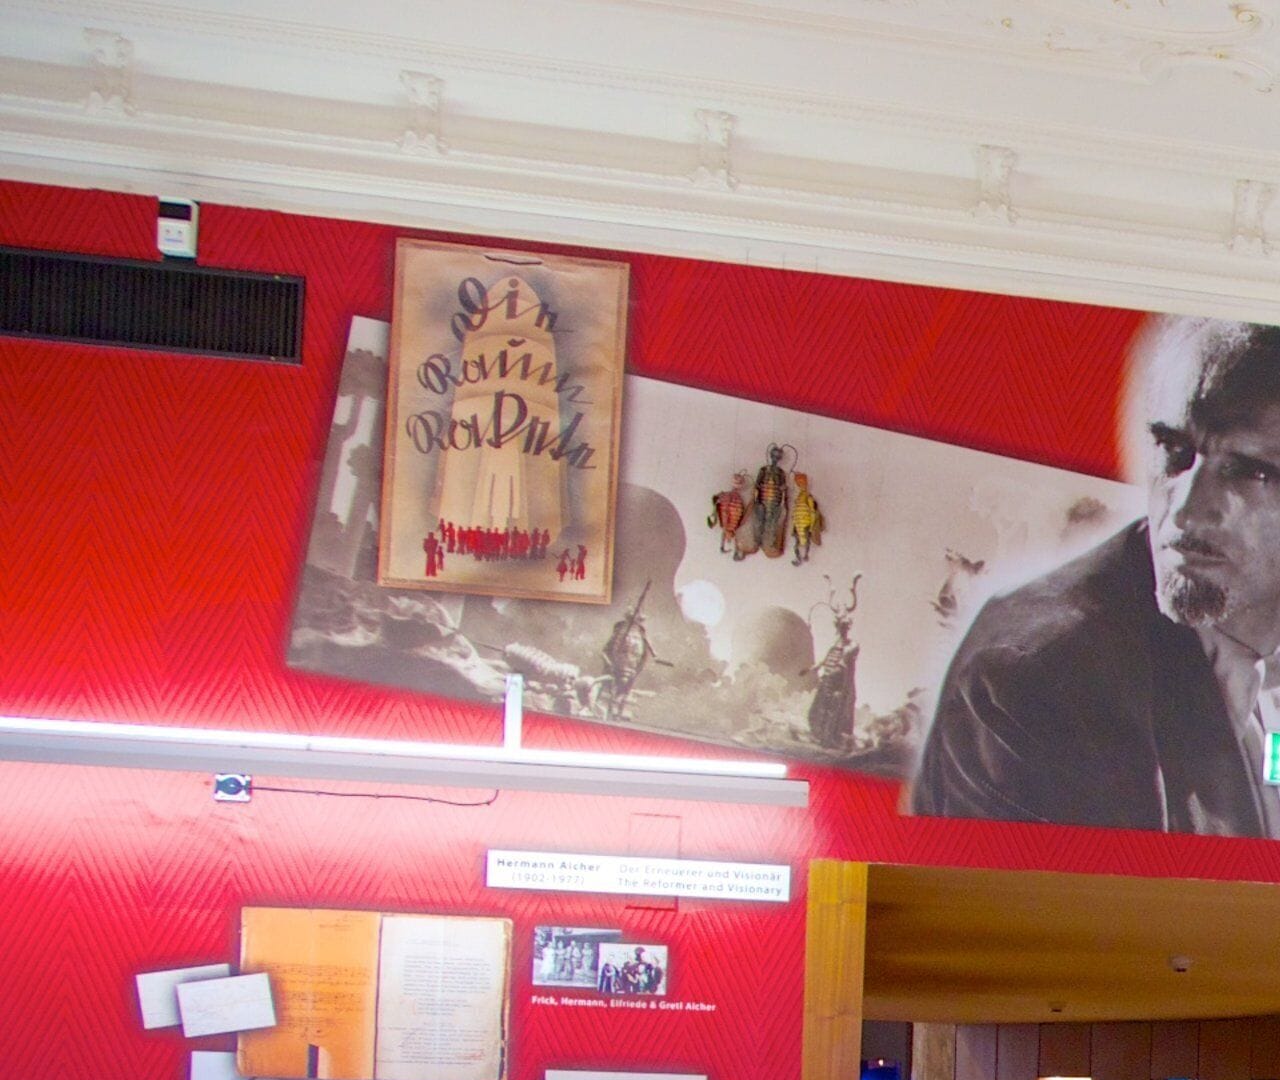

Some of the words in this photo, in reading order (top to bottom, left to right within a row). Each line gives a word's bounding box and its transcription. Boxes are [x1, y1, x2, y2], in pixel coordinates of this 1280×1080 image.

[496, 858, 555, 870] Hermann
[559, 860, 602, 873] Aicher
[707, 868, 728, 880] und
[618, 876, 639, 888] The
[643, 878, 698, 892] Reformer
[702, 882, 724, 893] and
[727, 884, 783, 897] Visionary
[685, 1001, 717, 1012] Aicher
